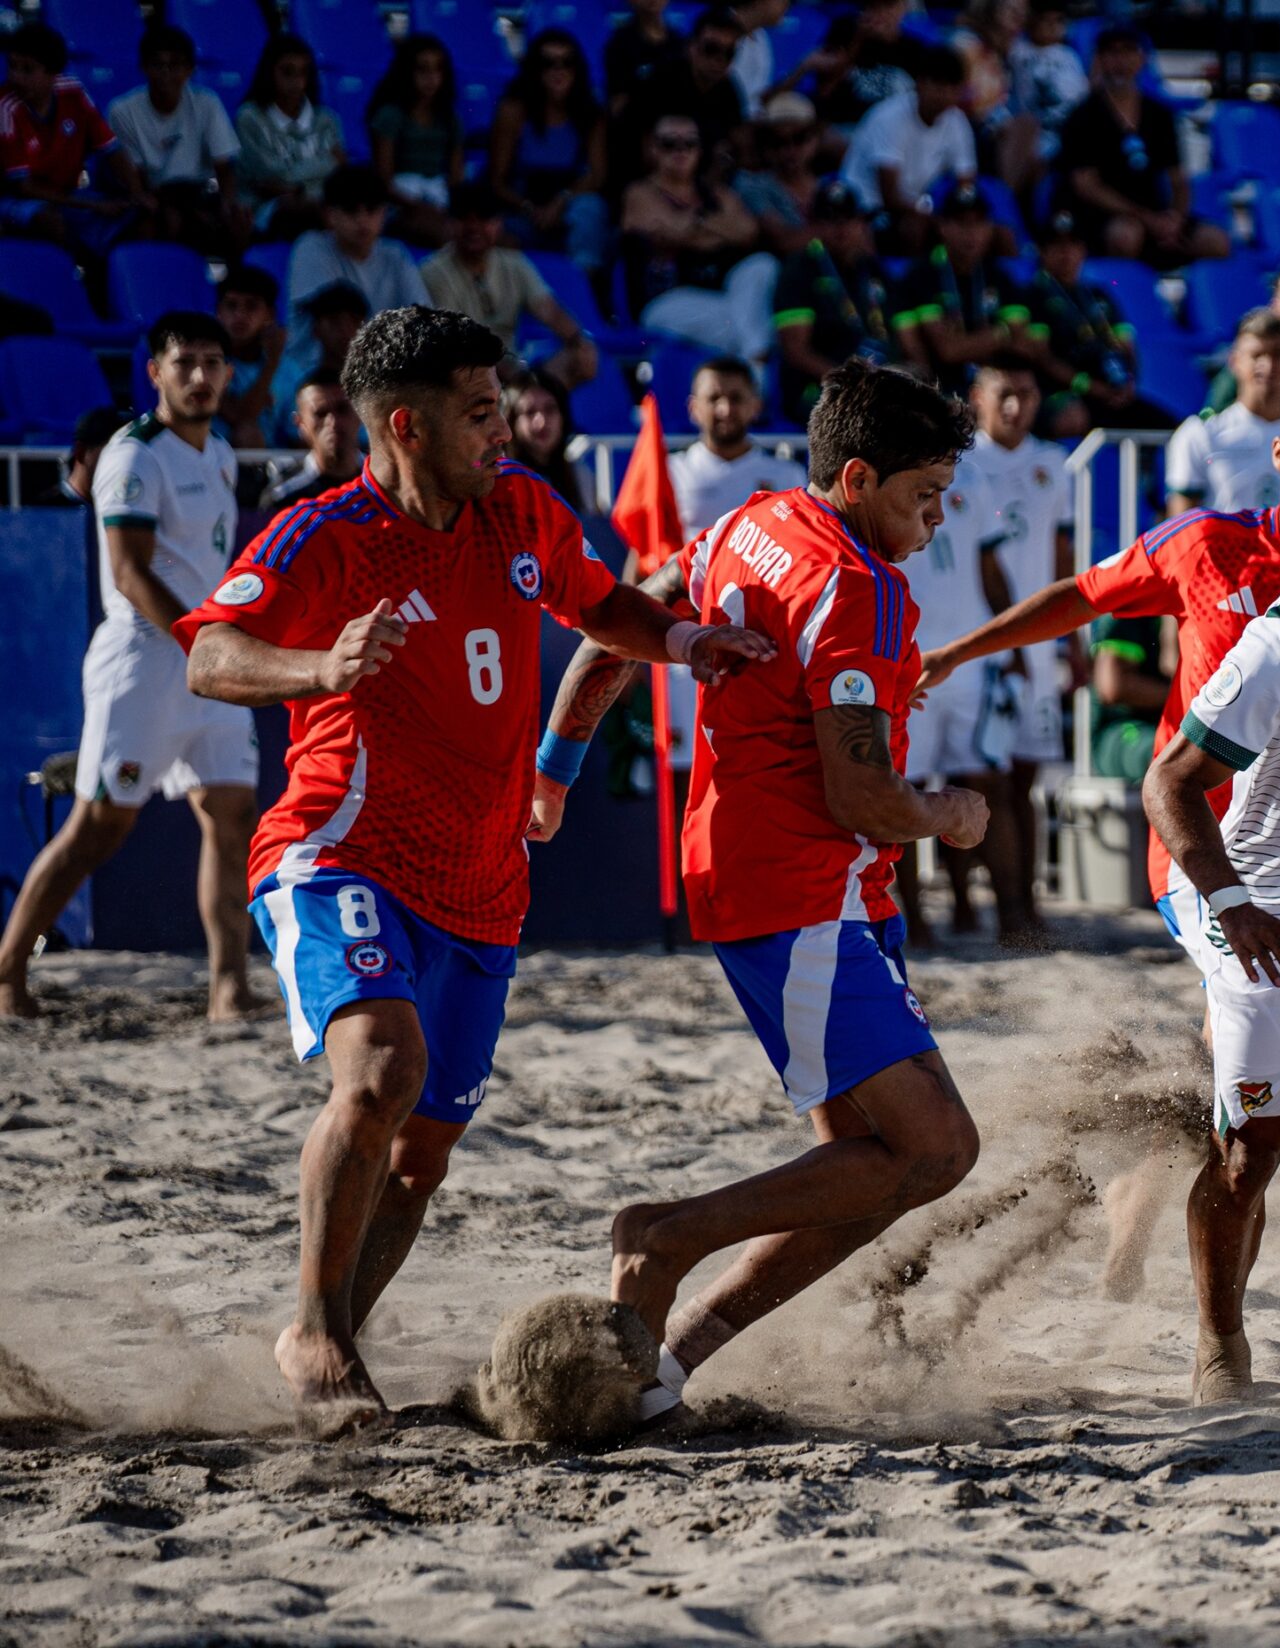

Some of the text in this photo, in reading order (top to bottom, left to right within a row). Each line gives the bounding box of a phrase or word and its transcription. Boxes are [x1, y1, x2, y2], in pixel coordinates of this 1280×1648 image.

[728, 516, 793, 588] BOLVAR
[465, 627, 504, 706] 8
[337, 885, 381, 938] 8
